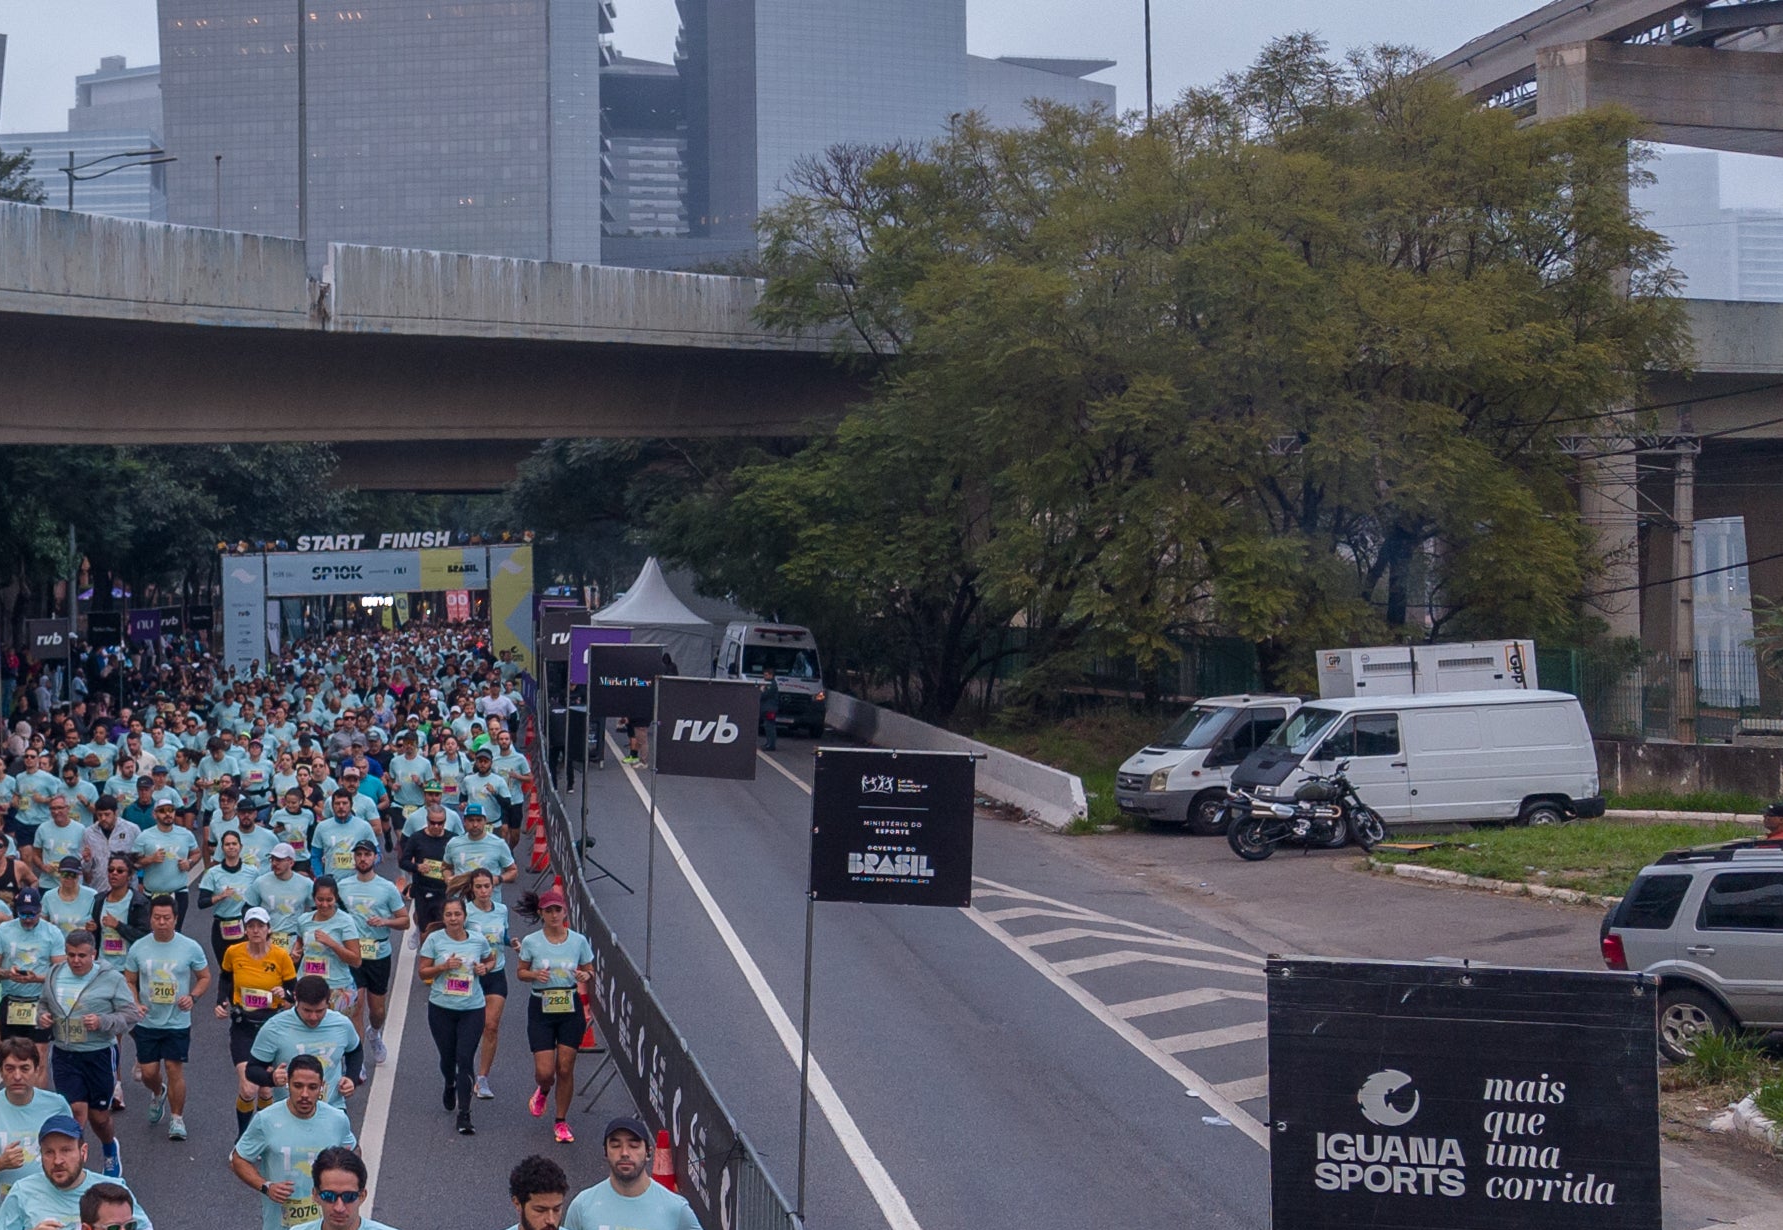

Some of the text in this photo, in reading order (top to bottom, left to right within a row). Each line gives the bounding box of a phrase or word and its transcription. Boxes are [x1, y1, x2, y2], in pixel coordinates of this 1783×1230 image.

[297, 531, 451, 551] START FINISH
[312, 565, 363, 580] SP10K
[36, 632, 63, 646] rvb
[551, 632, 569, 645] rv
[599, 676, 652, 688] Market Place
[672, 714, 739, 744] rvb
[848, 852, 935, 877] BRASIL
[1483, 1073, 1566, 1104] mais
[1483, 1110, 1546, 1142] que
[1316, 1132, 1465, 1166] IGUANA
[1485, 1144, 1561, 1170] uma
[1314, 1162, 1466, 1197] SPORTS
[1485, 1173, 1616, 1206] corrida
[289, 1204, 319, 1219] 2076
